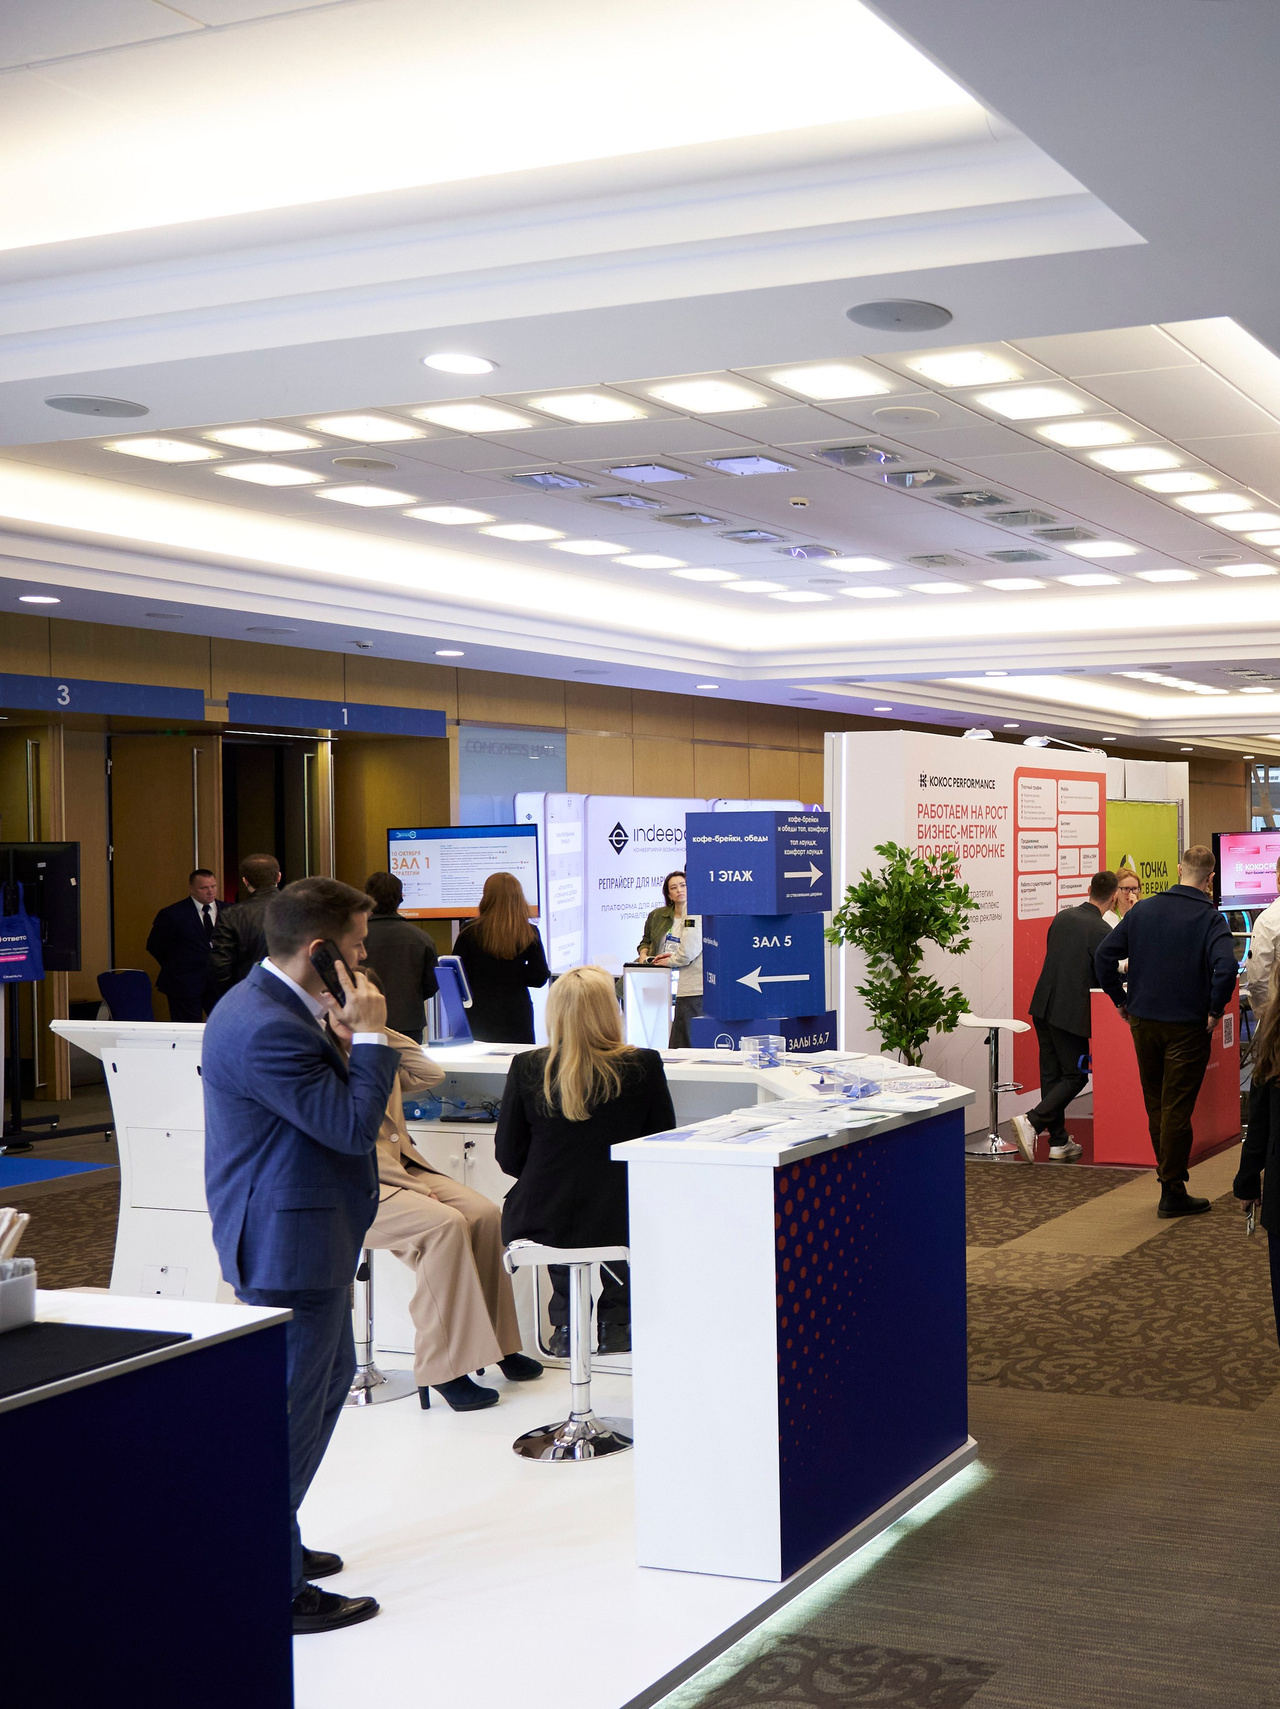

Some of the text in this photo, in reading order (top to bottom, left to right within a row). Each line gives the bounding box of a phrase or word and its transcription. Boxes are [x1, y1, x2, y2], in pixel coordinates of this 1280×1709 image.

[57, 684, 71, 706] 3
[342, 708, 348, 725] 1
[952, 777, 996, 790] PERFORMANCE
[917, 803, 969, 820] РАБОТАЕМ
[970, 805, 984, 820] НА
[985, 805, 1008, 820] РОСТ
[692, 834, 769, 844] кофе-брейки, обеды
[917, 824, 998, 840] БИЗНЕС-МЕТРИК
[962, 844, 1005, 859] ВОРОНКЕ
[391, 857, 420, 870] ЗАЛ
[424, 856, 430, 869] 1
[1140, 861, 1168, 879] ТОЧКА
[598, 876, 635, 890] РЕПРАЙСЕР
[635, 877, 650, 889] ДЛЯ
[709, 870, 754, 882] 1 ЭТАЖ
[601, 903, 638, 912] ПЛАТФОРМА
[638, 902, 650, 911] ДЛЯ
[980, 913, 1003, 924] рекламы
[752, 935, 792, 948] ЗАЛ 5
[788, 1032, 829, 1050] ЗАЛЫ 5,6,7
